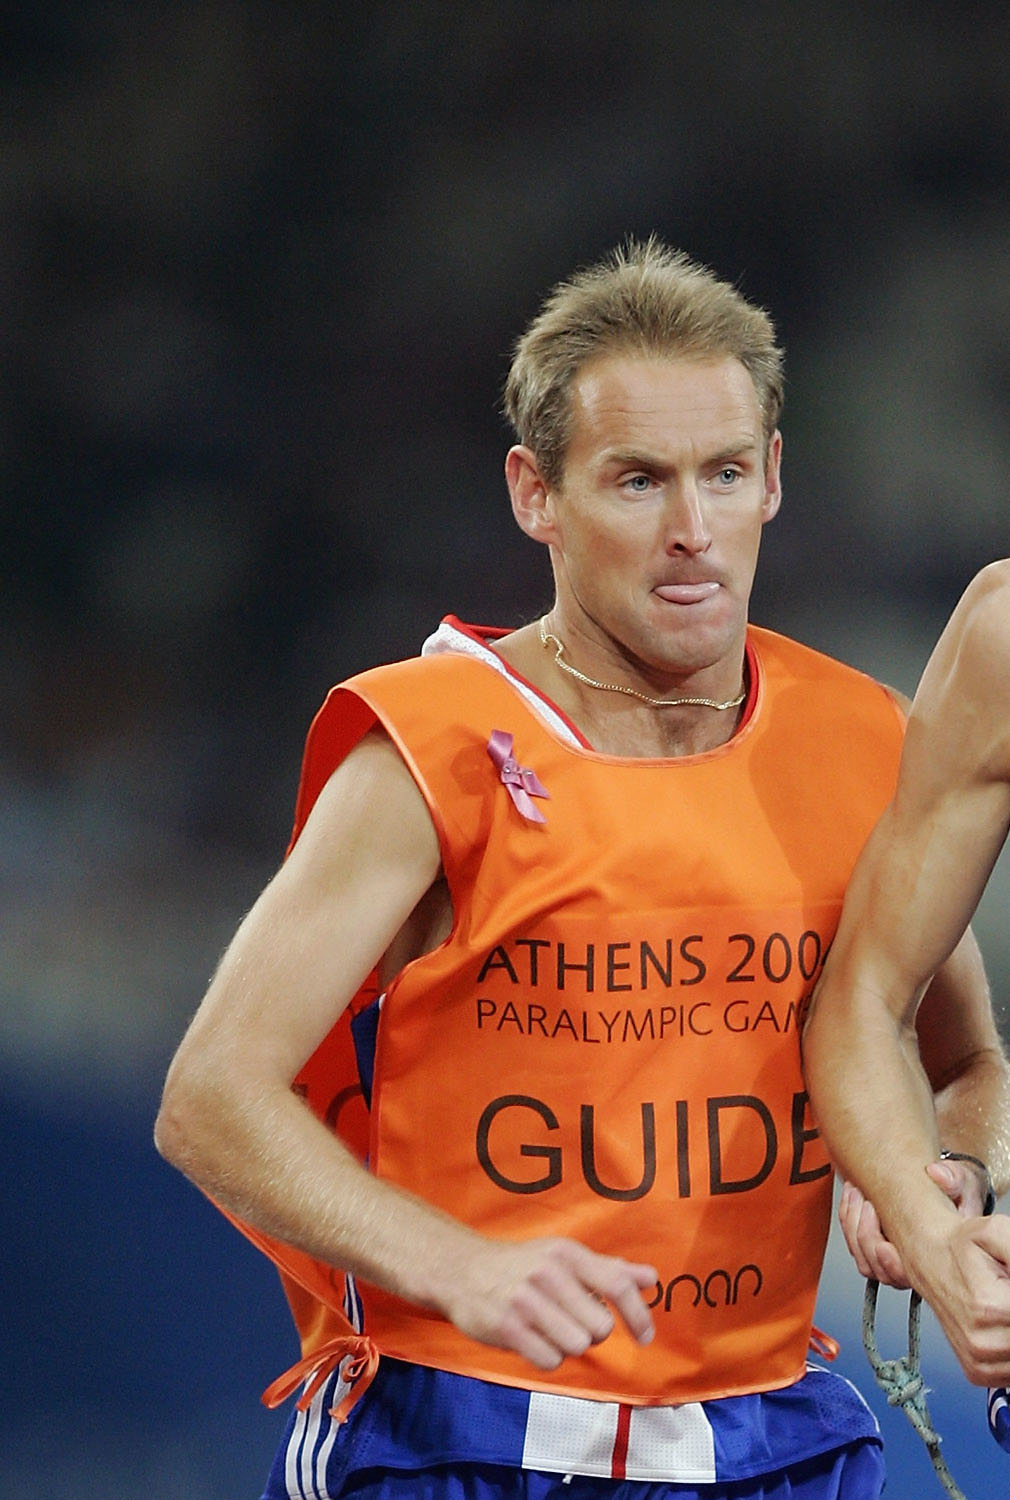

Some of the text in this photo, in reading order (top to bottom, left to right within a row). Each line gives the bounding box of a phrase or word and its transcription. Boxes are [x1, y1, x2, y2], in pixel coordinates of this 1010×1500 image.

[476, 934, 708, 993] ATHENS
[476, 998, 714, 1044] PARALYMPIC
[475, 1089, 832, 1202] GUIDE
